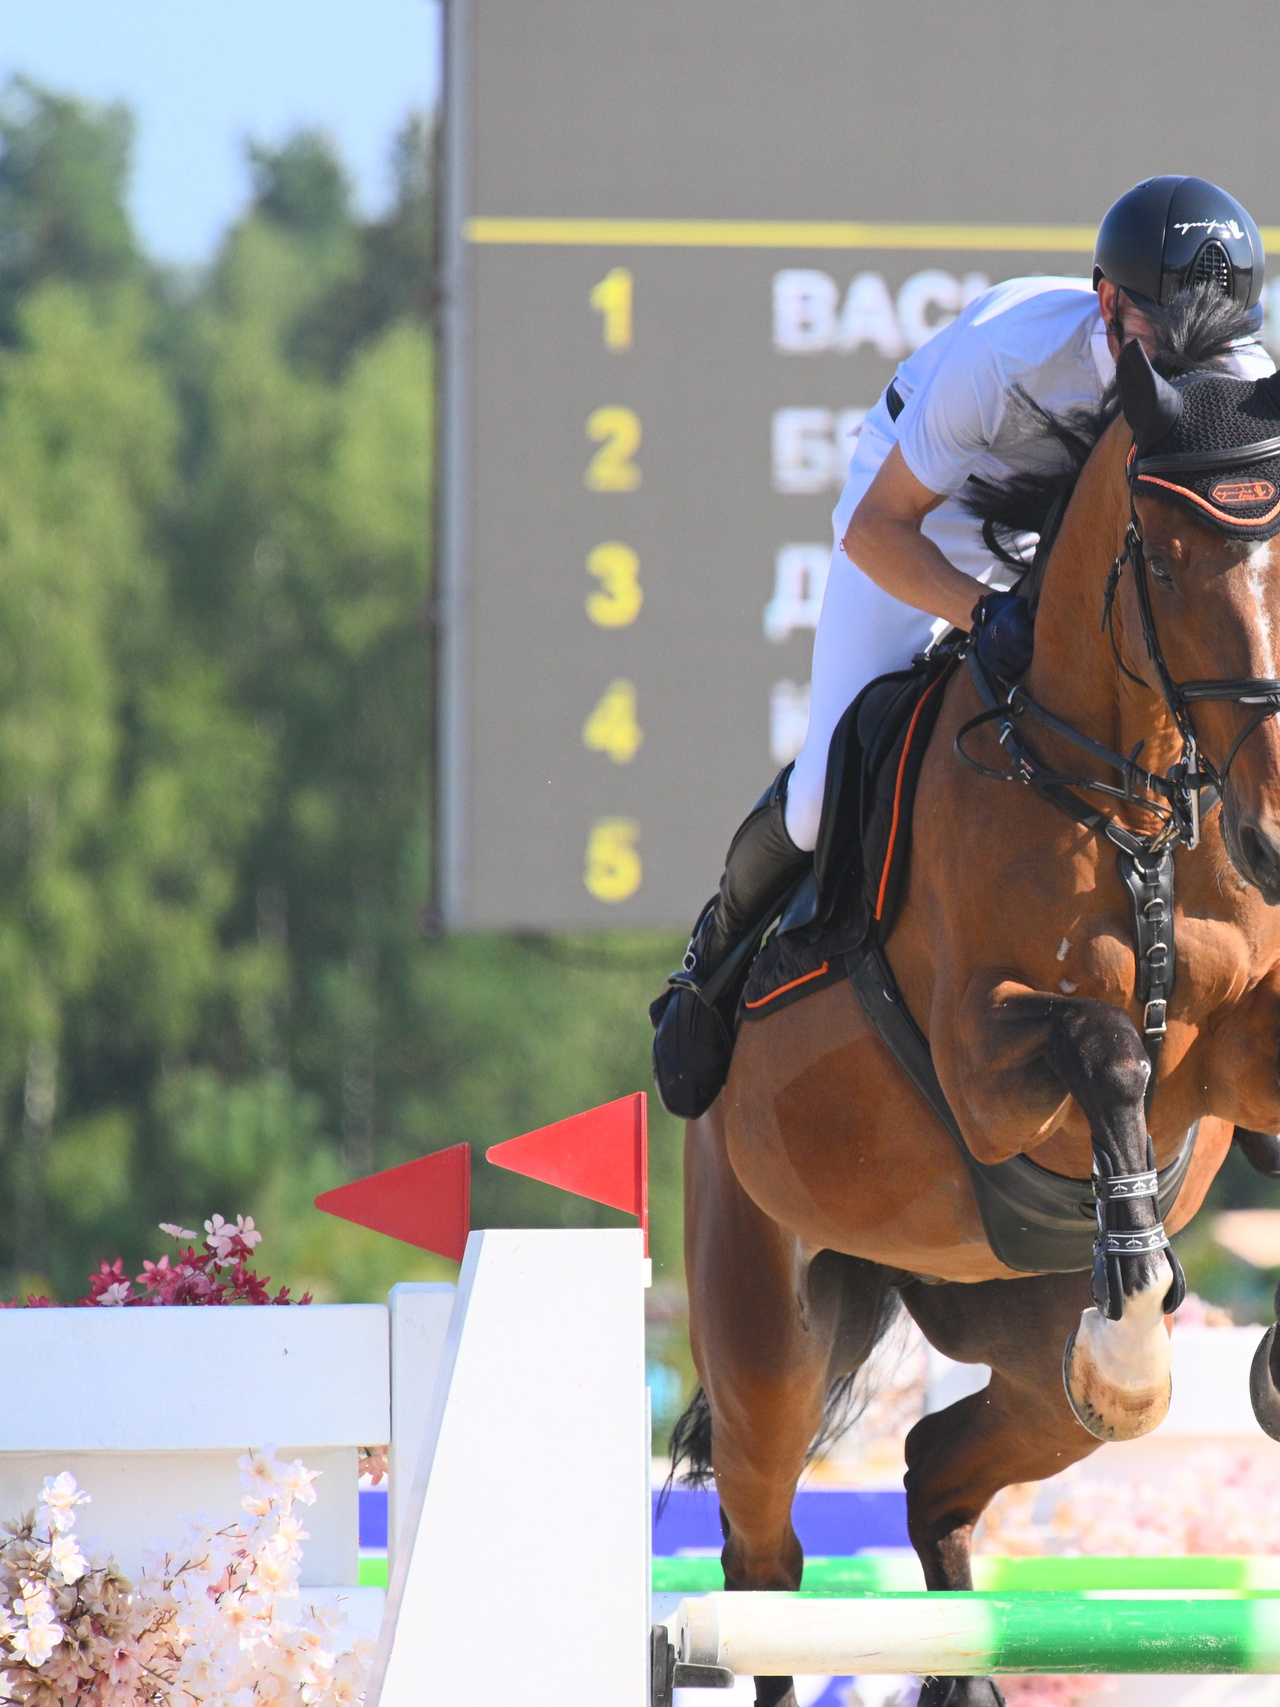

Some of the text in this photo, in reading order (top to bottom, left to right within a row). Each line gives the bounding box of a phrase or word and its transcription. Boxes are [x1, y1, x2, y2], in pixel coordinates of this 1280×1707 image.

[589, 267, 633, 352] 1
[583, 404, 643, 494] 2
[584, 540, 644, 629] 3
[582, 677, 644, 765] 4
[583, 815, 643, 902] 5
